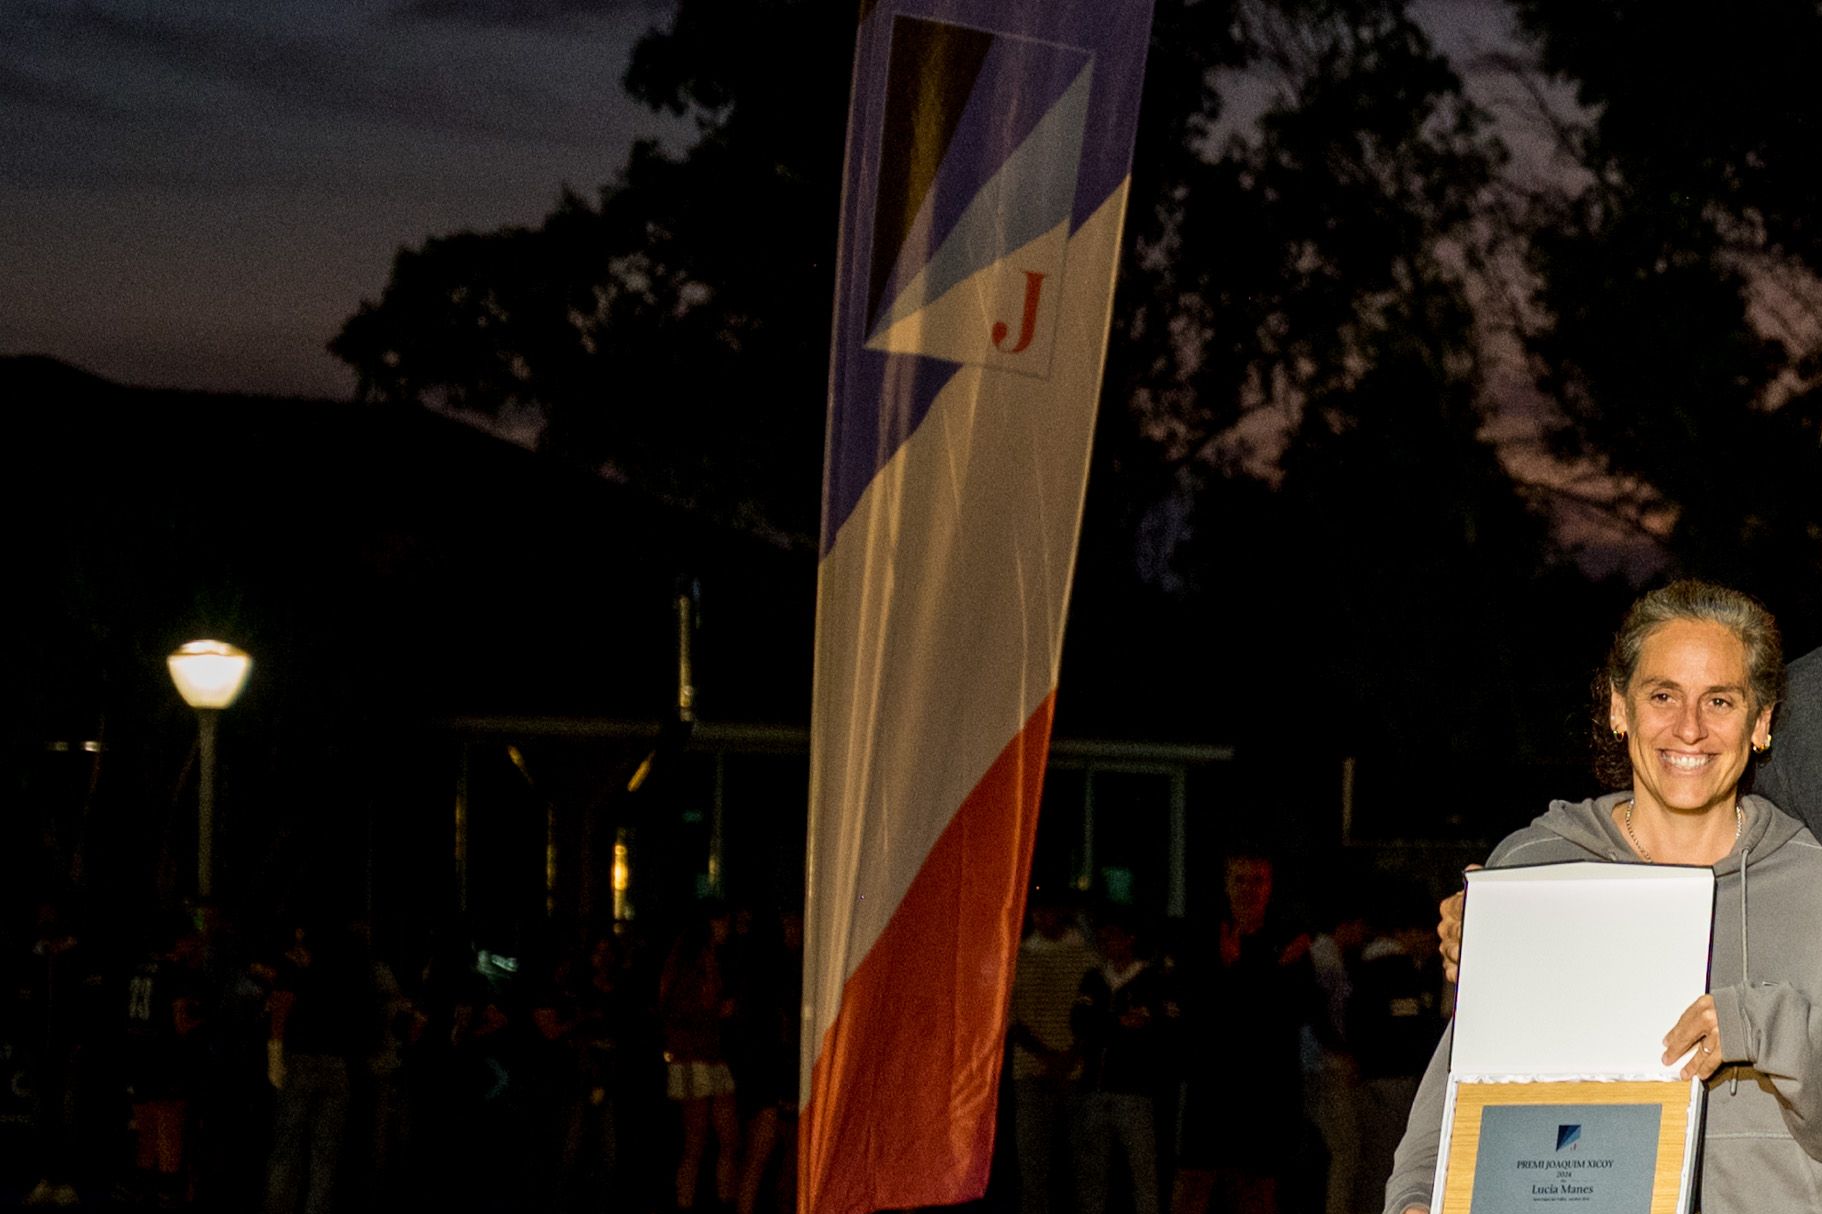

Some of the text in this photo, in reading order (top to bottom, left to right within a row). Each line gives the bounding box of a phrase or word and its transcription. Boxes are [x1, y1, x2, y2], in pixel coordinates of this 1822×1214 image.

[992, 270, 1048, 353] J
[1517, 1160, 1614, 1170] PREMI JOAQUIM XICOY
[1560, 1184, 1594, 1195] Manes
